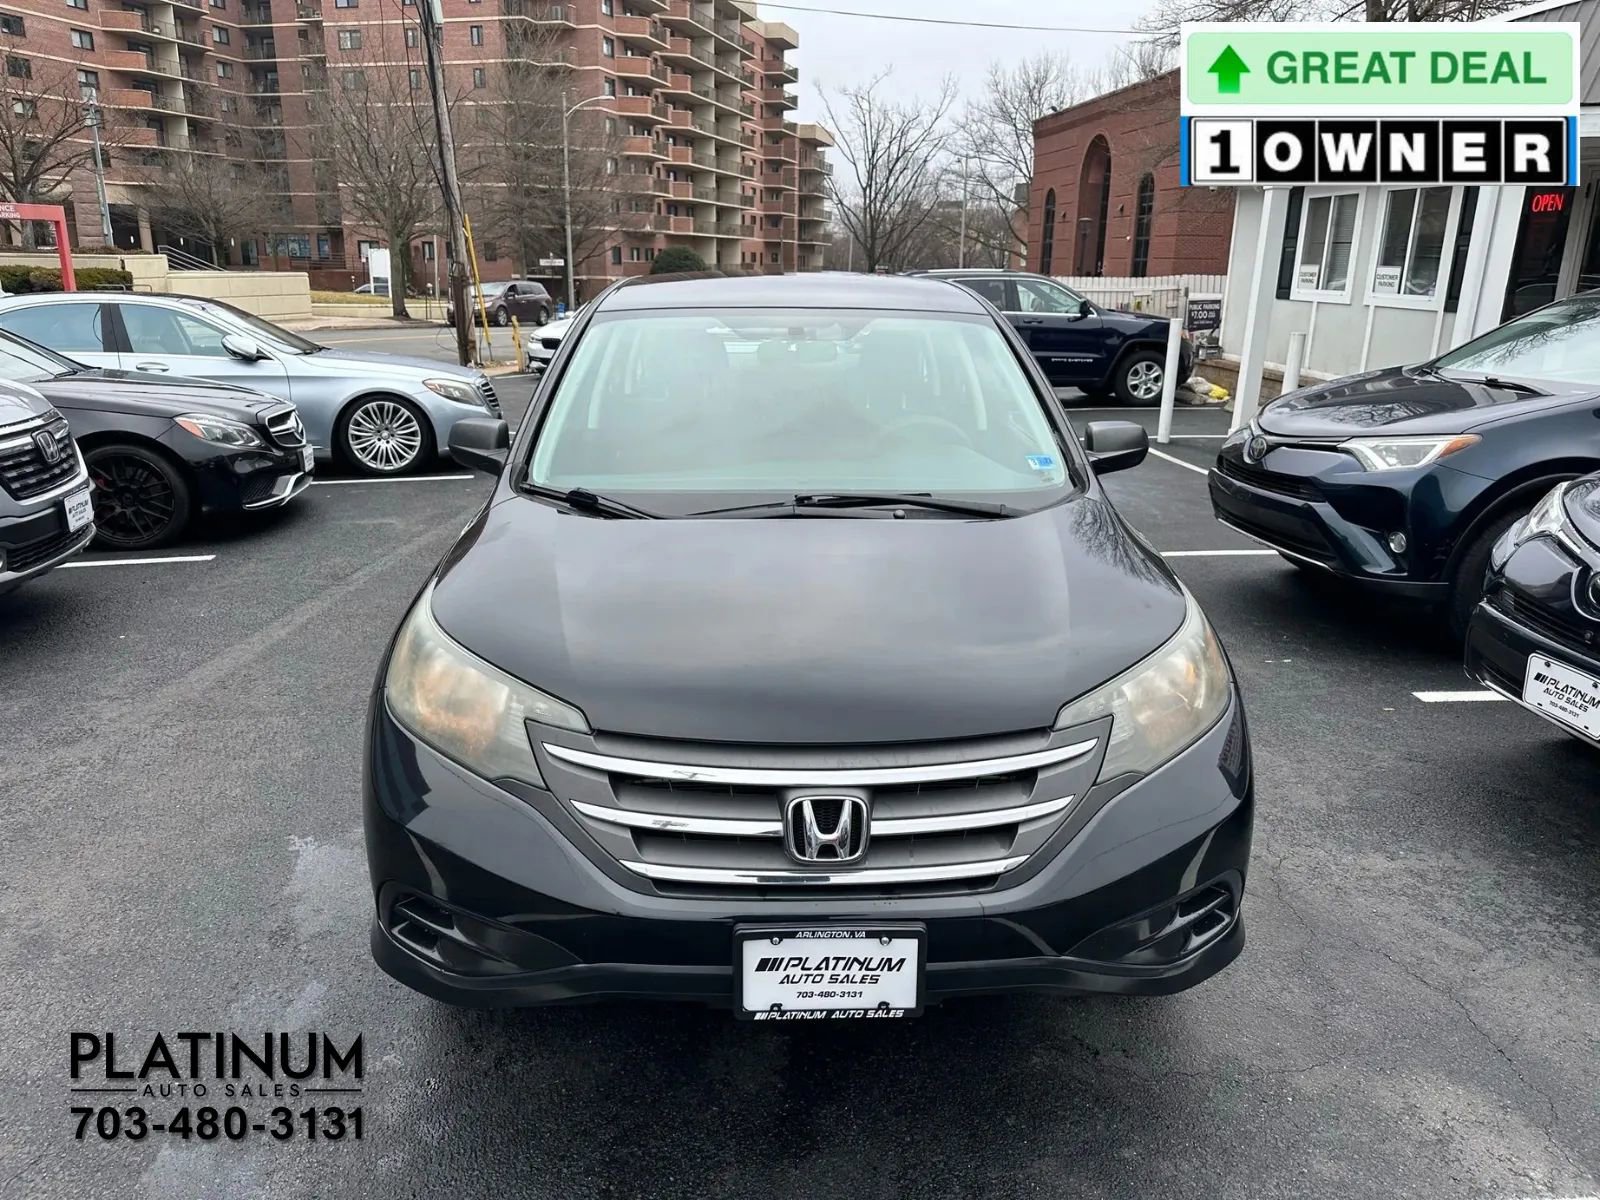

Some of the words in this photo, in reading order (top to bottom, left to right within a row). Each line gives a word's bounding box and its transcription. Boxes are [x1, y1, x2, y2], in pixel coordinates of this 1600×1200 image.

[1532, 193, 1564, 212] OPEN
[1376, 273, 1399, 281] CUSTOMER
[1543, 687, 1565, 700] AUTO
[1564, 696, 1589, 712] SALES
[1546, 677, 1600, 709] PLATINUM
[783, 956, 907, 972] PLATINUM
[779, 974, 824, 984] AUTO
[827, 974, 881, 984] SALES
[796, 991, 863, 999] 703-480-3131
[767, 1010, 827, 1020] PLATINUM
[831, 1010, 864, 1019] AUTO
[866, 1009, 905, 1018] SALES
